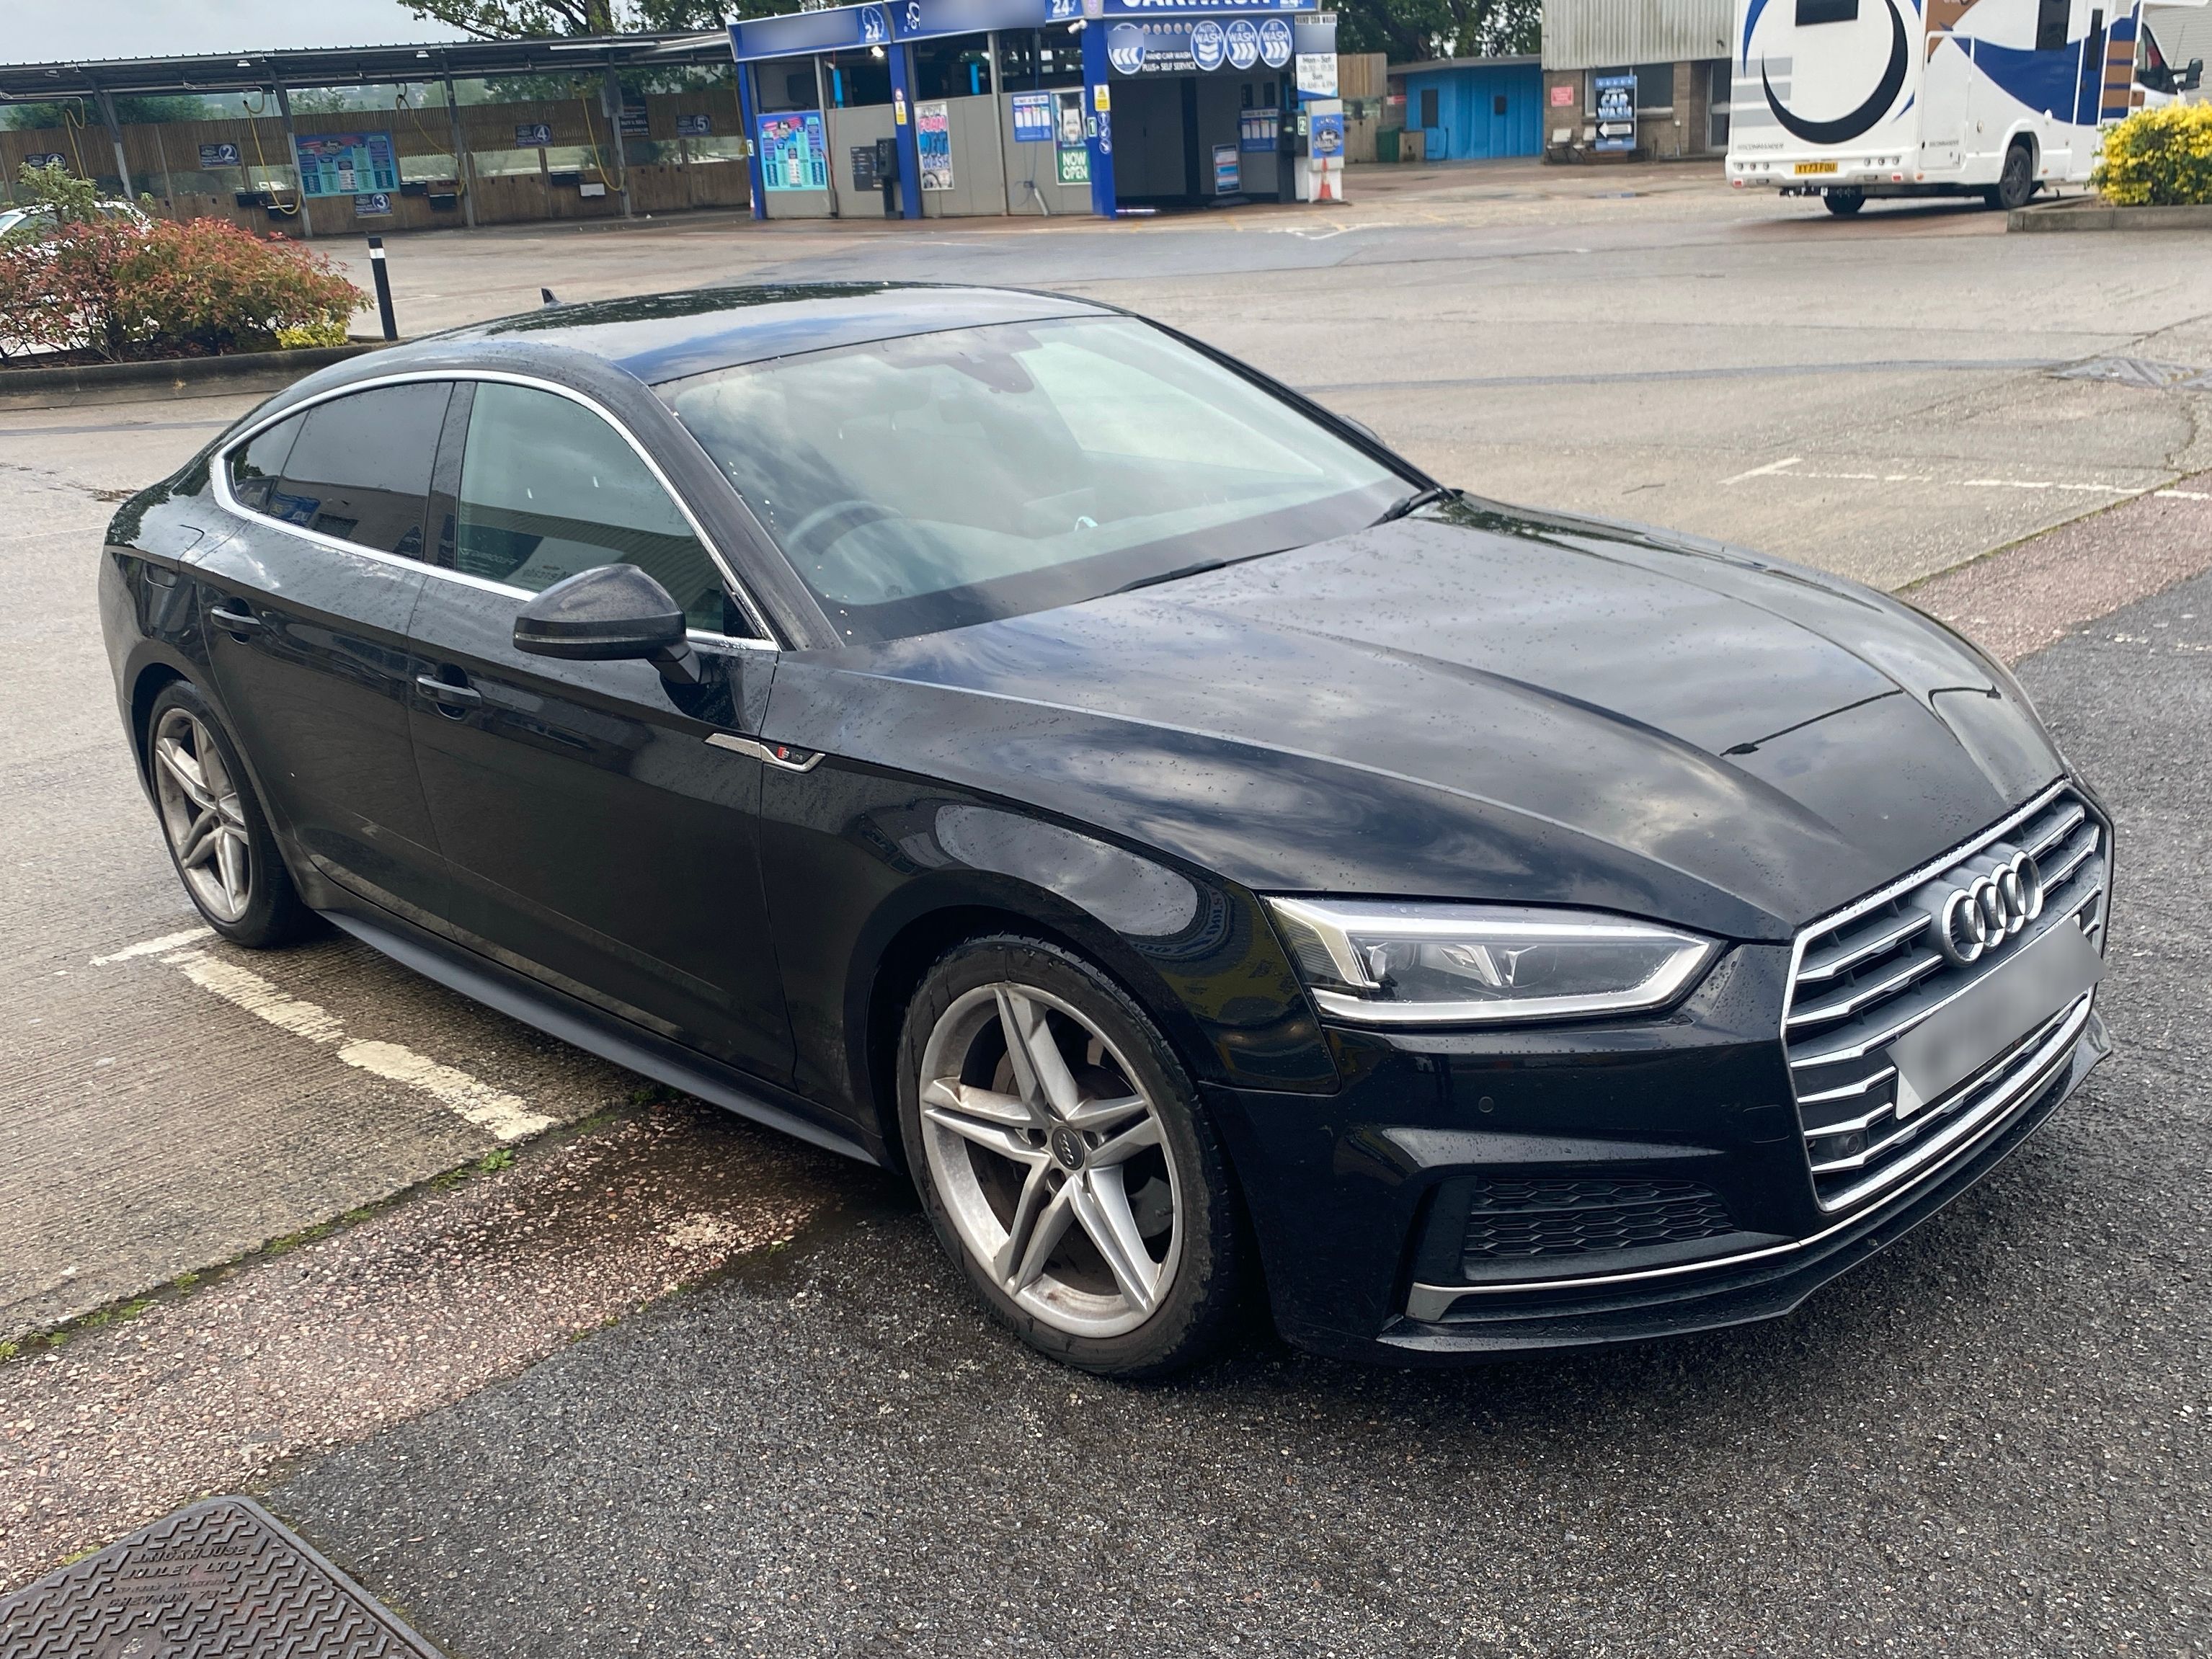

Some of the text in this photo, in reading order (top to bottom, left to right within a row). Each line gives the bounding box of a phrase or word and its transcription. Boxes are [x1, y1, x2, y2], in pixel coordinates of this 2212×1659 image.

[865, 24, 879, 40] 24
[1193, 32, 1222, 43] WASH
[1228, 32, 1256, 43] WASH
[1261, 30, 1289, 41] WASH
[1601, 94, 1629, 108] CAR
[1598, 106, 1633, 119] WASH
[696, 117, 706, 130] 5
[919, 116, 947, 132] FOAM
[537, 126, 547, 141] 4
[222, 146, 234, 160] 2
[1062, 152, 1086, 166] NOW
[922, 155, 949, 169] WASH
[1062, 166, 1088, 179] OPEN
[376, 195, 386, 208] 3
